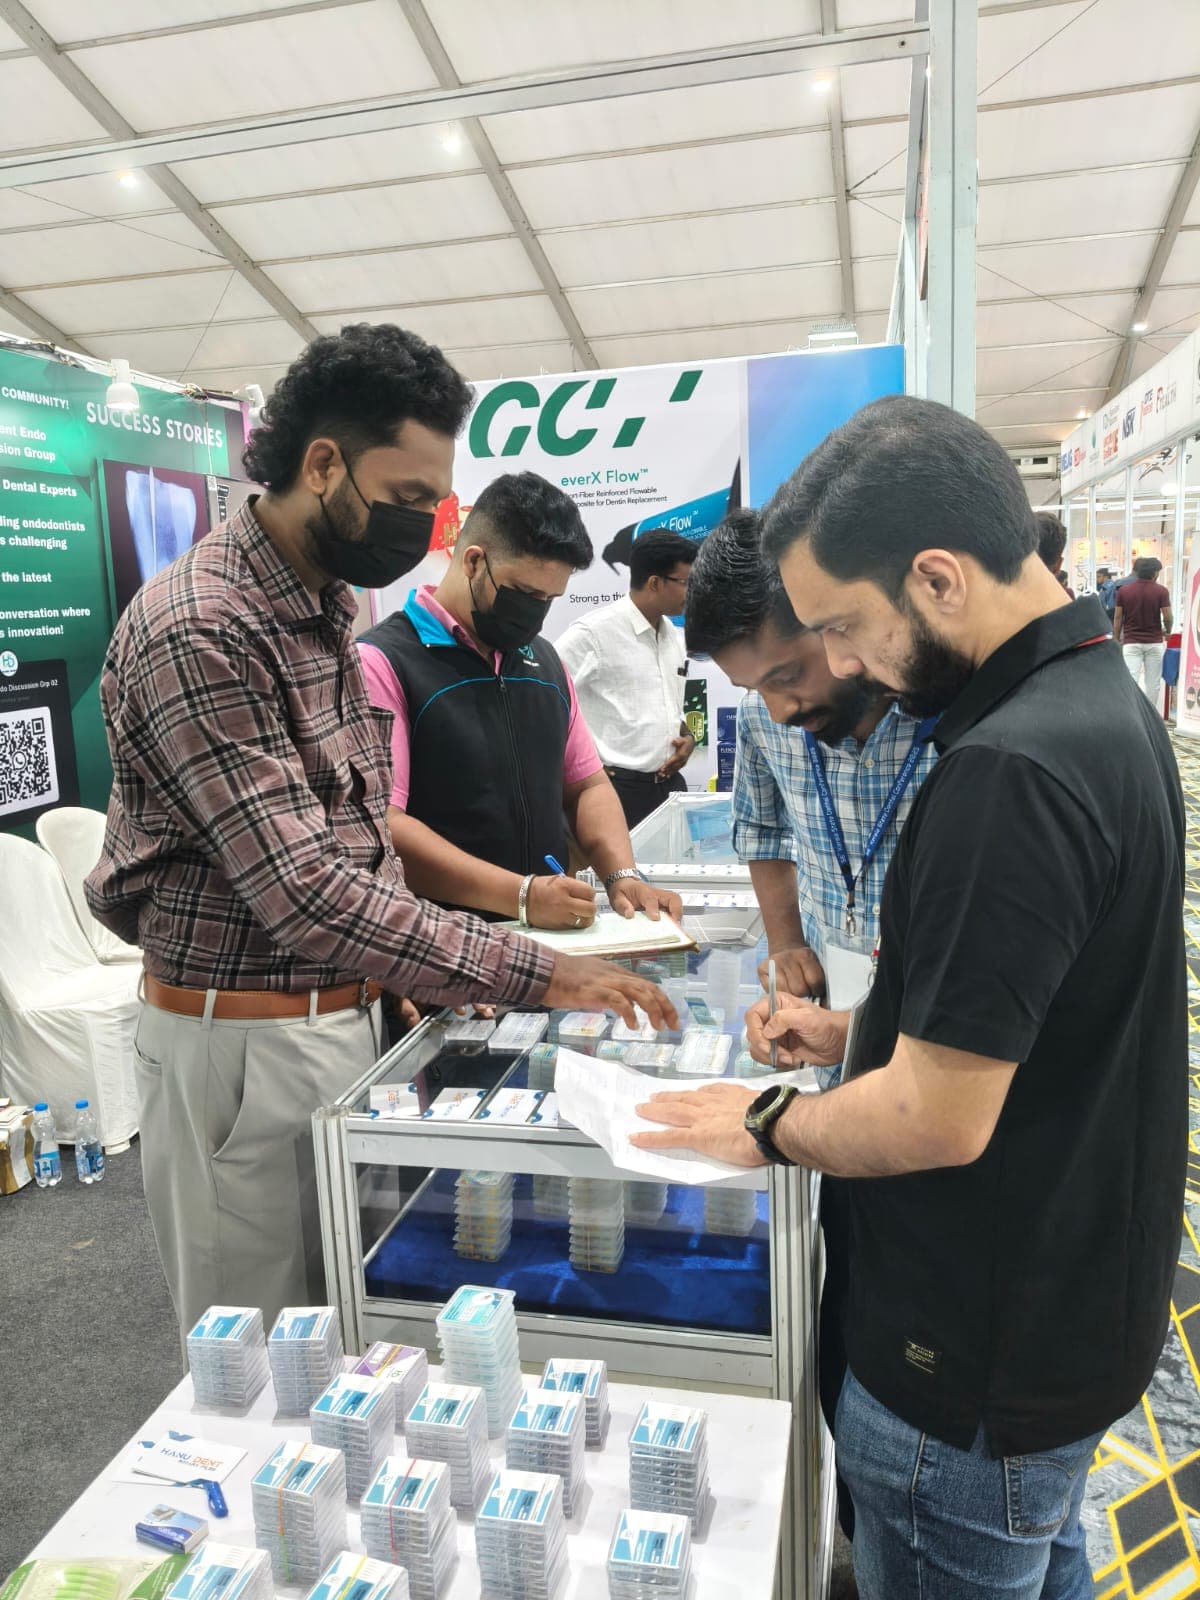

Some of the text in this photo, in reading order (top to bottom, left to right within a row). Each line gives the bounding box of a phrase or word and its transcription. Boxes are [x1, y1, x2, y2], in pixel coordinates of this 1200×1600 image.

[1, 386, 69, 410] COMMUNITY!
[86, 402, 223, 448] SUCCESS STORIES
[20, 426, 46, 440] Endo
[24, 446, 56, 463] Group
[561, 472, 601, 487] everX
[2, 479, 77, 498] Dental Experts
[597, 488, 628, 497] Reinforced
[630, 486, 658, 494] Flowable
[577, 495, 667, 509] posite for Dentin Replacement
[22, 518, 86, 531] endodontists
[9, 535, 68, 551] challenging
[1, 571, 52, 582] the latest
[570, 594, 599, 604] Strong
[601, 594, 610, 602] to
[61, 607, 91, 617] where
[8, 624, 64, 638] innovation!
[9, 683, 39, 691] Discussion
[160, 1447, 224, 1468] HANU DENT
